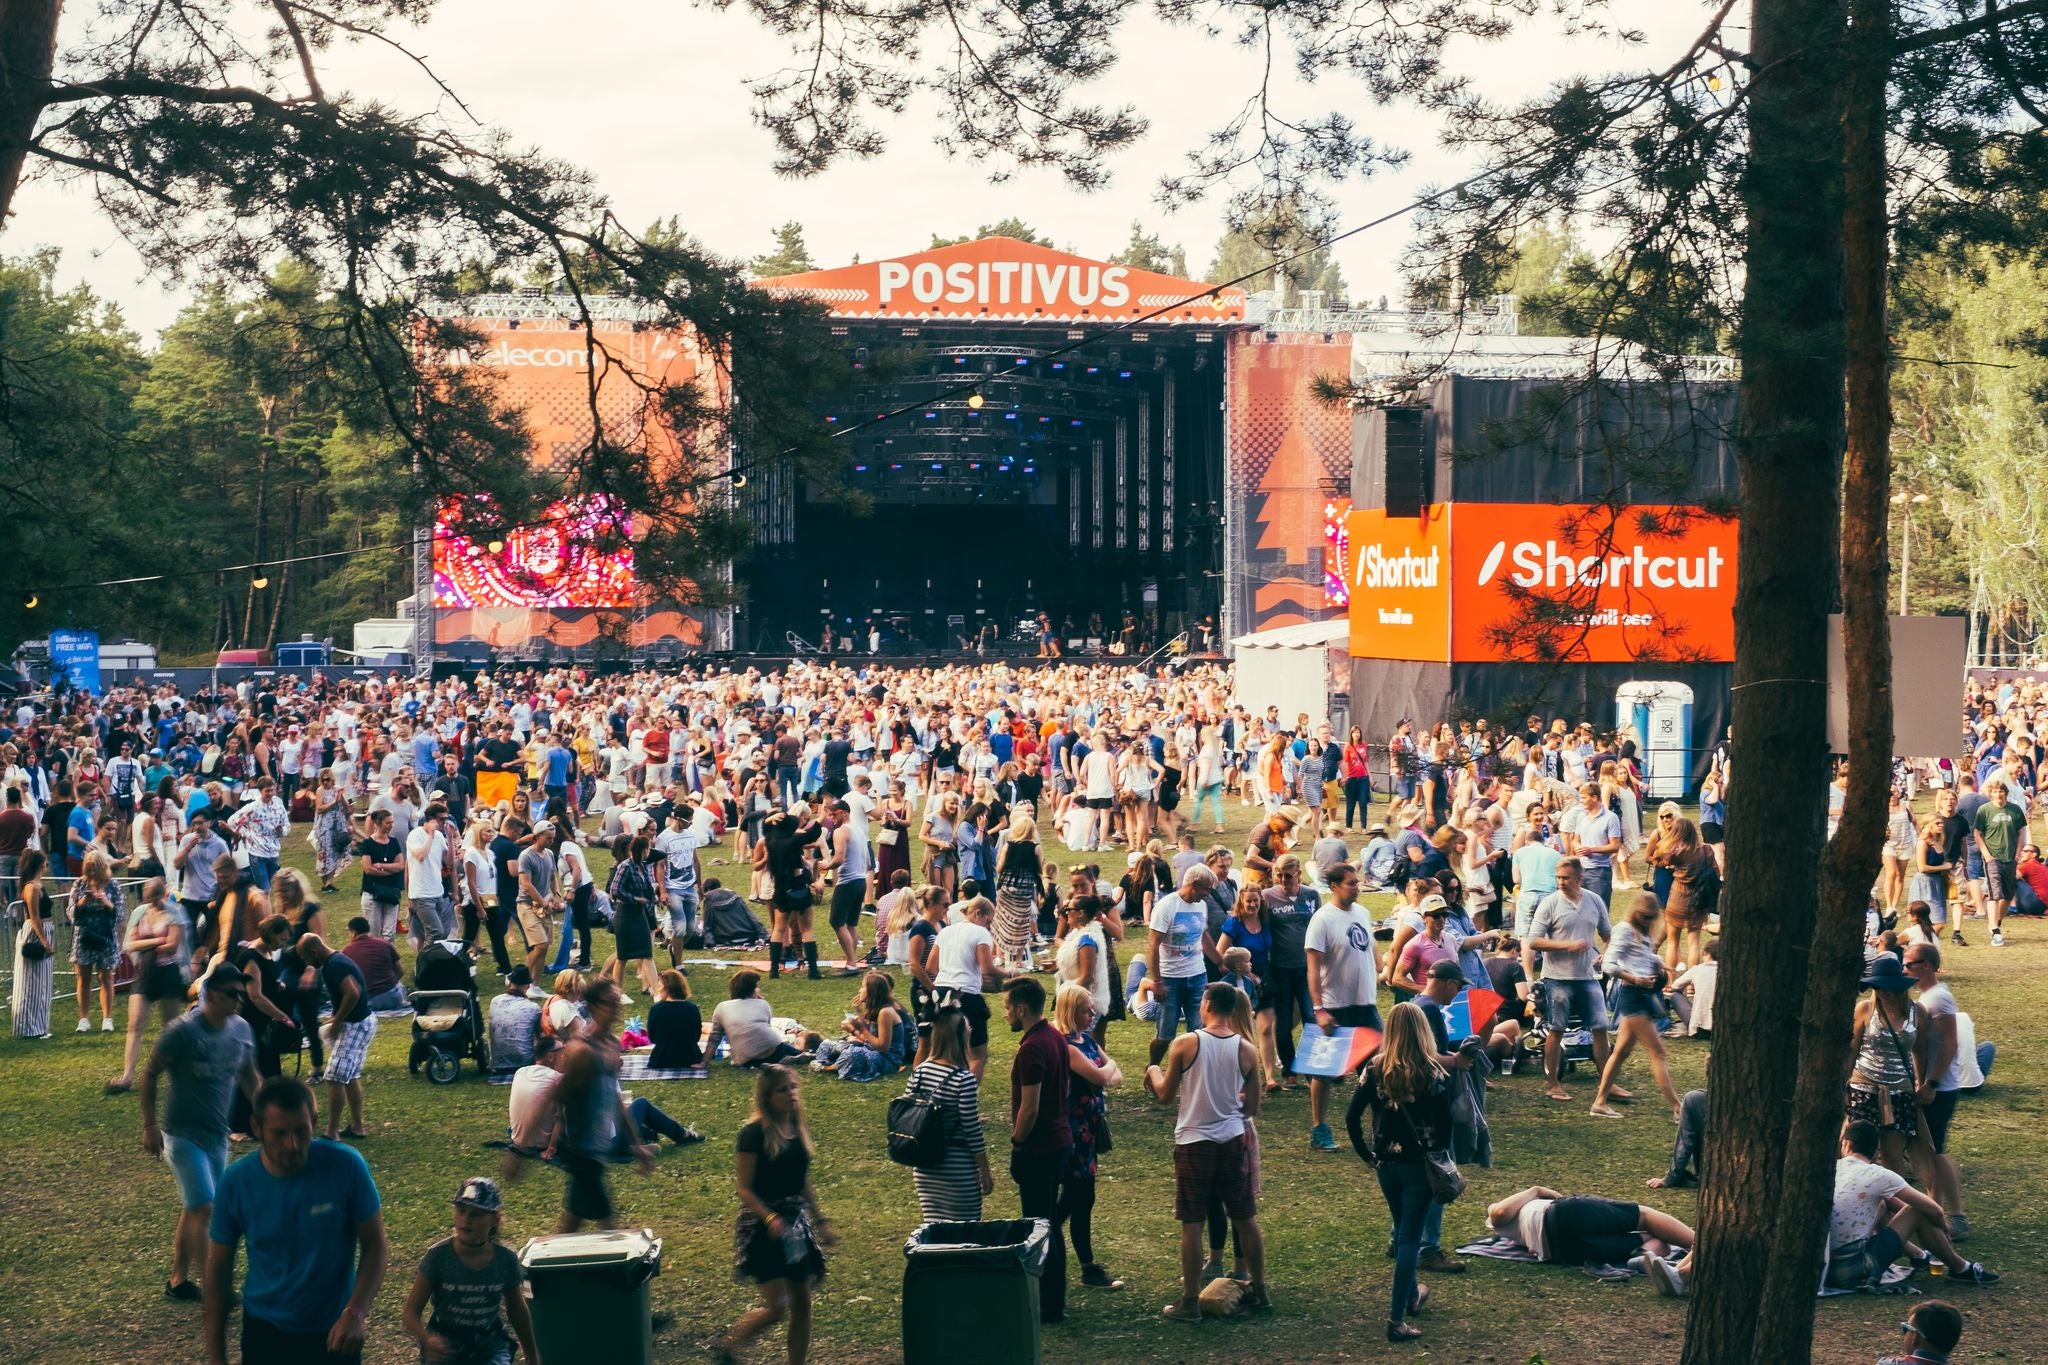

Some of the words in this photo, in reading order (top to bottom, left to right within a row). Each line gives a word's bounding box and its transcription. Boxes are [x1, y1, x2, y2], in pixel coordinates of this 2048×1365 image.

[878, 262, 1130, 307] POSITIVUS
[1366, 543, 1440, 588] Shortcut
[1511, 540, 1724, 589] Shortcut
[55, 643, 74, 651] FREE
